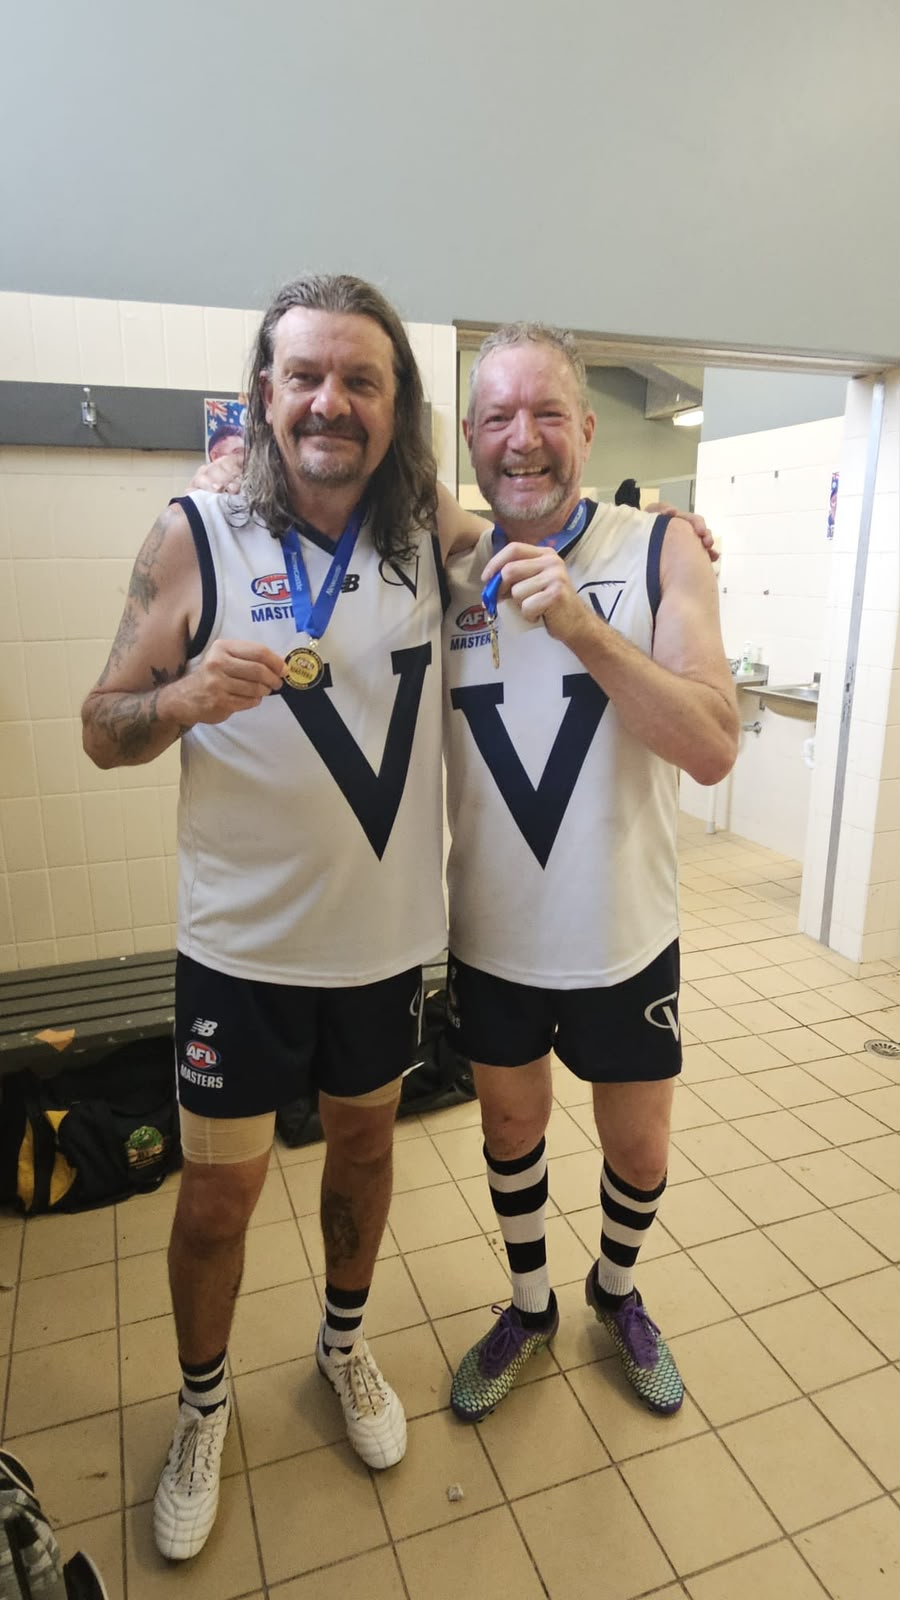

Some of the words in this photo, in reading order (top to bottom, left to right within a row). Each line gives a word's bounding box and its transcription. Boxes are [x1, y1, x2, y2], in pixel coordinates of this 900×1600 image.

[341, 573, 360, 593] B
[270, 640, 432, 862] V
[450, 672, 611, 871] V
[186, 1045, 217, 1065] AFL
[180, 1063, 224, 1089] MASTERS
